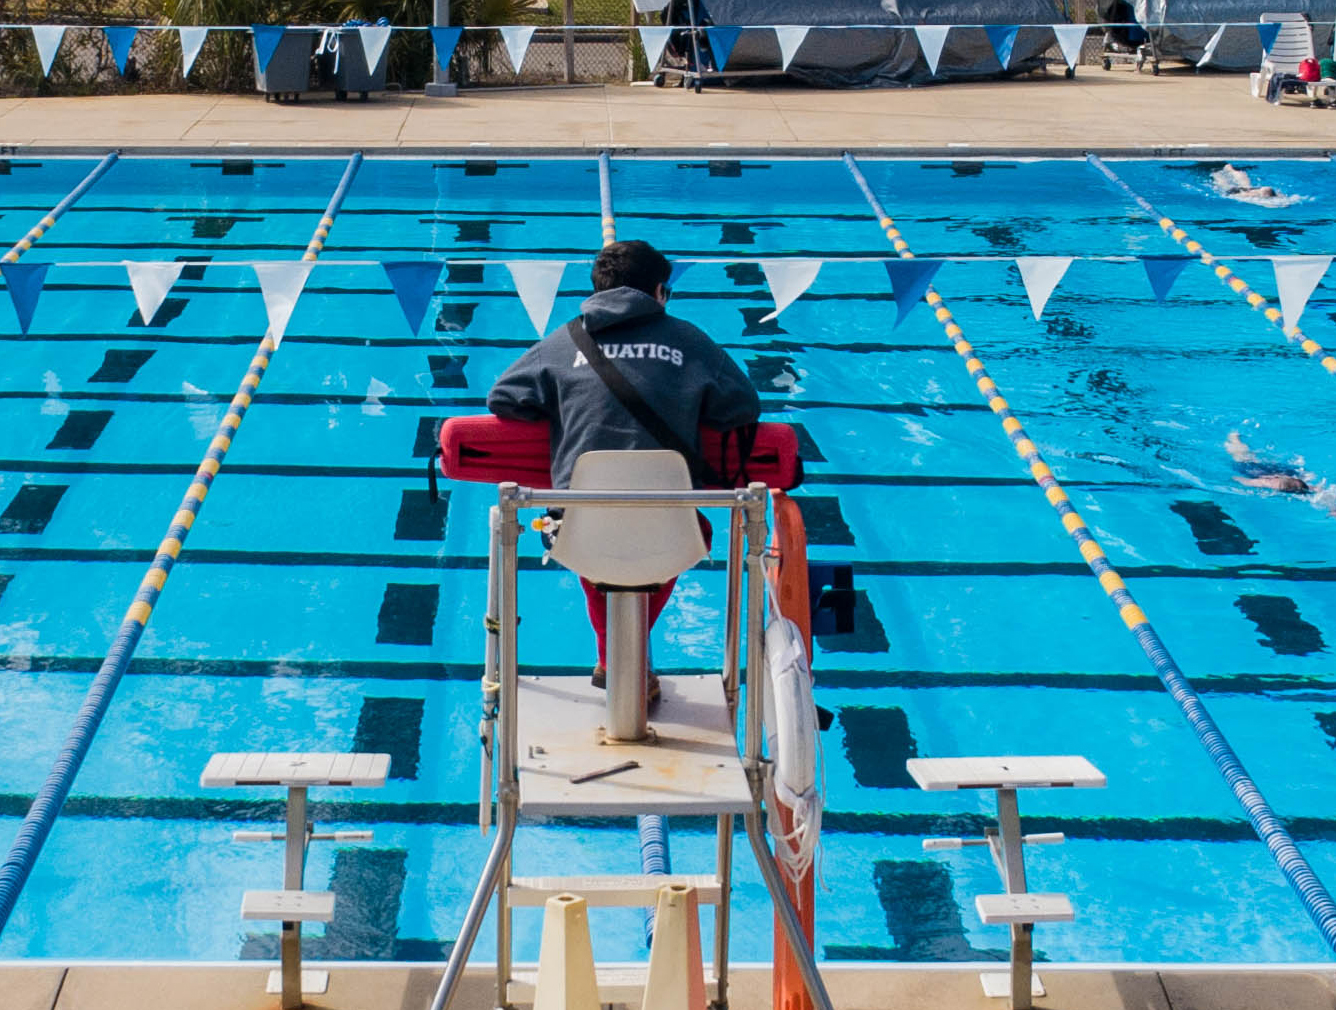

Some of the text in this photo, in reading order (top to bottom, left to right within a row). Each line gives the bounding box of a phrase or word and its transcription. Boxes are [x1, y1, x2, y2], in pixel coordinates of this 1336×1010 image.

[0, 147, 18, 156] FT
[1169, 148, 1186, 157] FT
[573, 343, 684, 368] AUATICS
